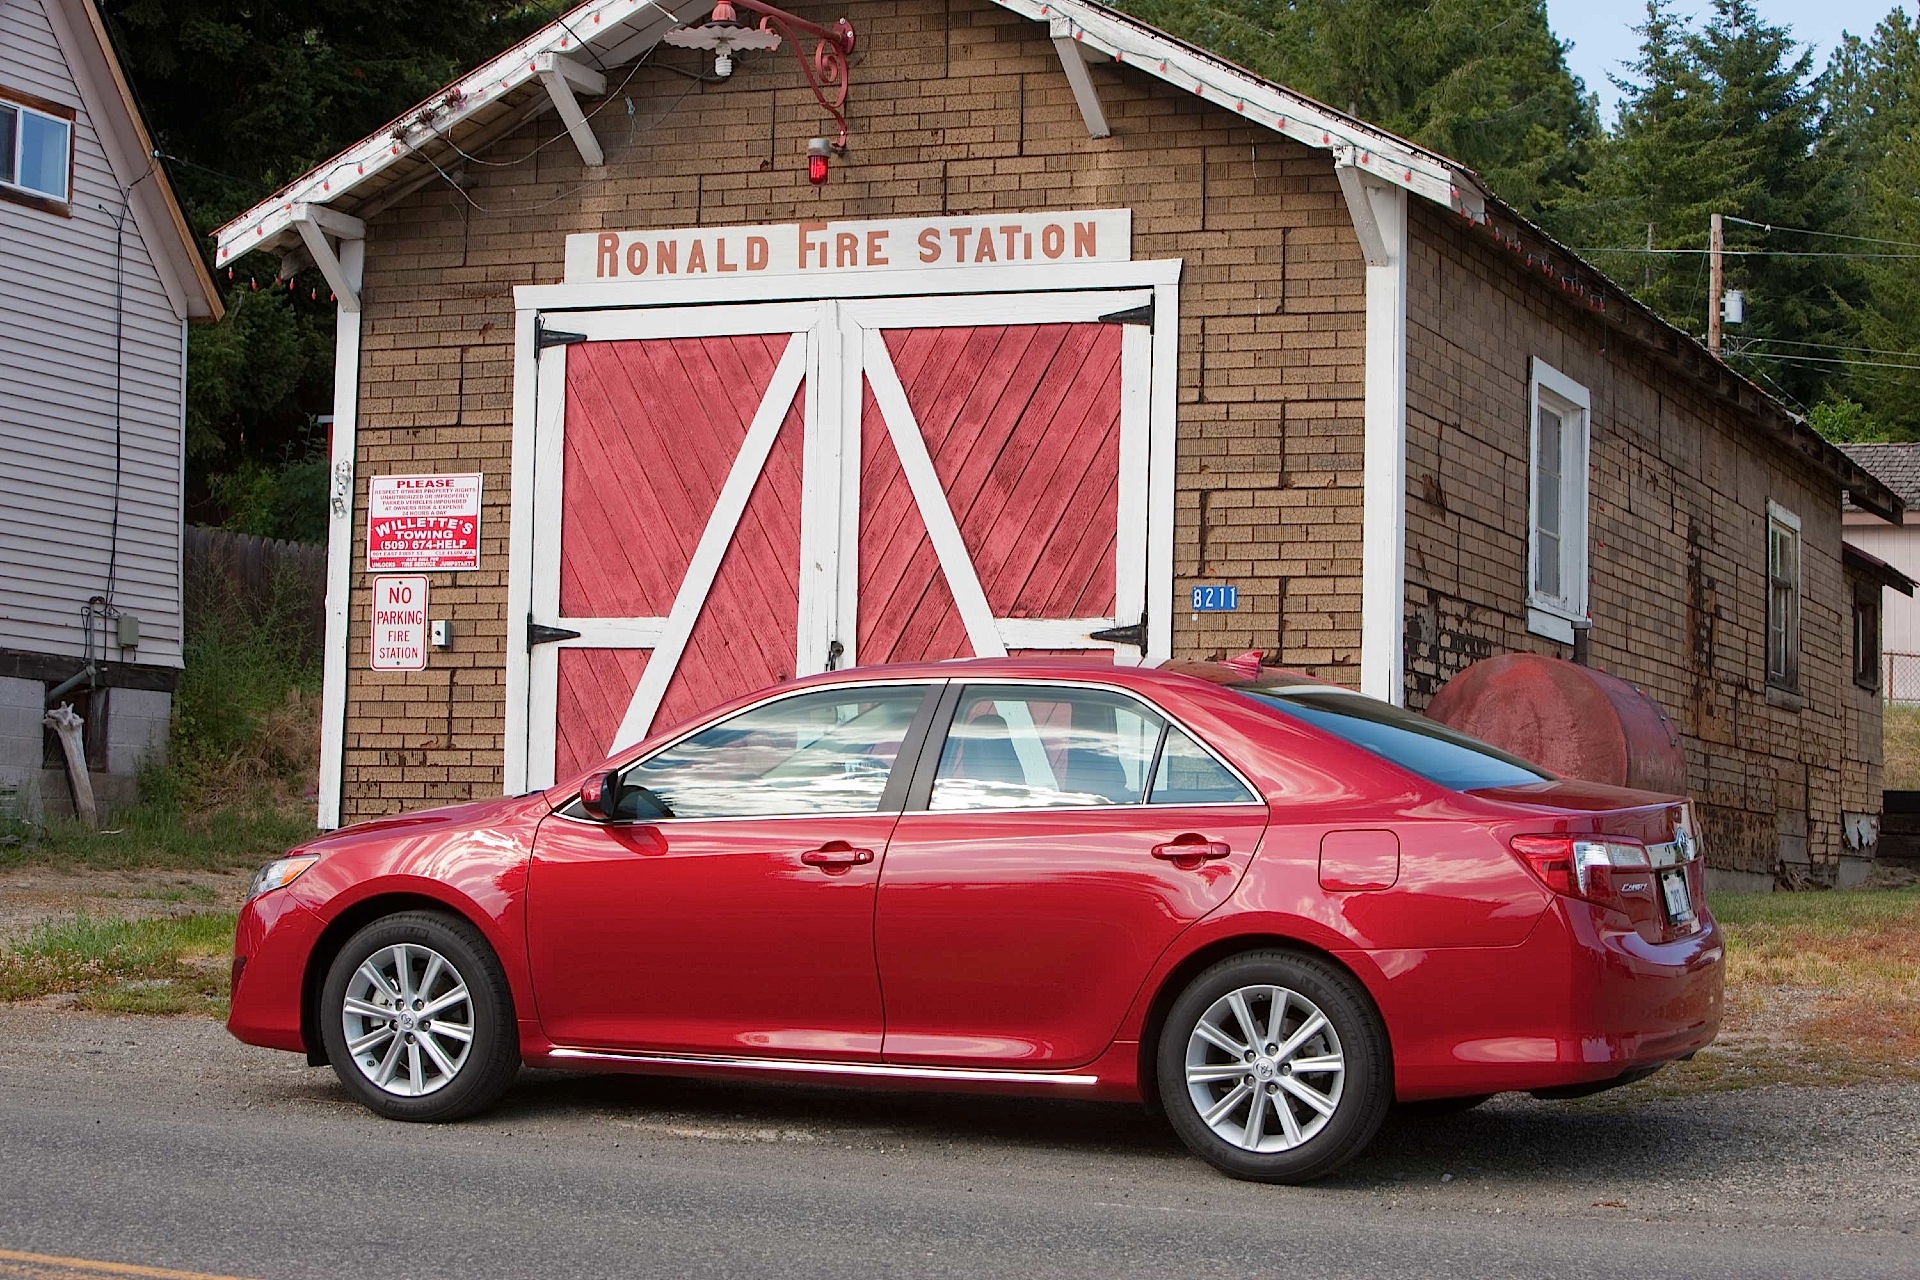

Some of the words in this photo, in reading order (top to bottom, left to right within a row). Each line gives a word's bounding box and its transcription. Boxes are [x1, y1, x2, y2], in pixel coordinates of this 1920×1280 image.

[396, 479, 455, 488] PLEASE
[374, 517, 474, 537] WILLETTE'S
[395, 530, 453, 540] TOWING
[380, 540, 408, 550] (509)
[412, 540, 467, 550] 674-HELP
[389, 587, 412, 604] NO
[1193, 588, 1236, 608] 8211
[377, 610, 423, 625] PARKING
[388, 630, 410, 642] FIRE
[379, 647, 418, 659] STATION
